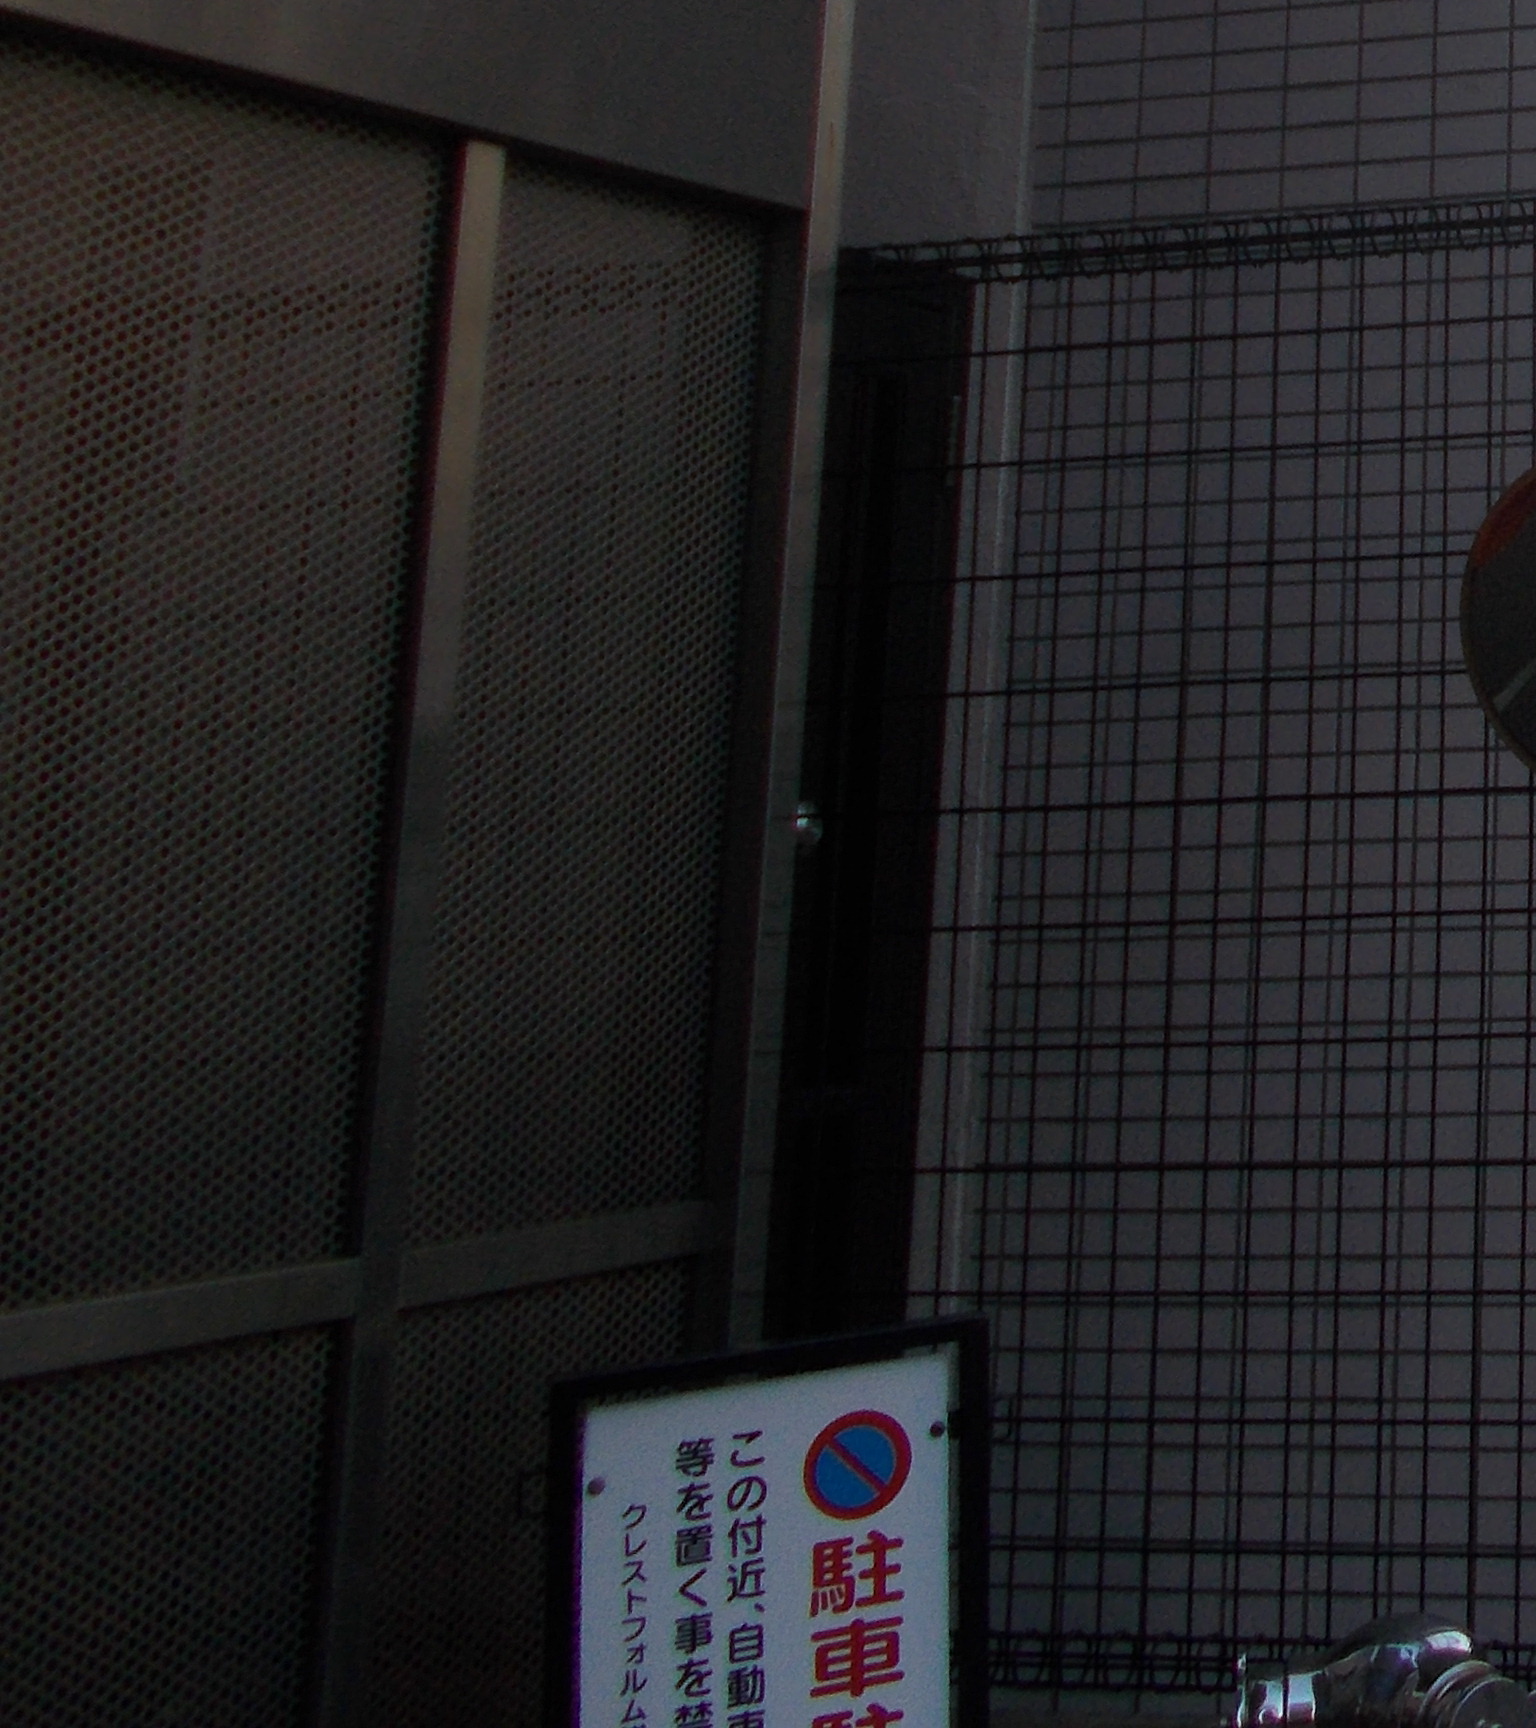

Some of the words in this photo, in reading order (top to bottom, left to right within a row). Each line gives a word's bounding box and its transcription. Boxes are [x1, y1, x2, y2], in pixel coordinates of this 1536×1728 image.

[619, 1503, 649, 1728] クレストフォルム
